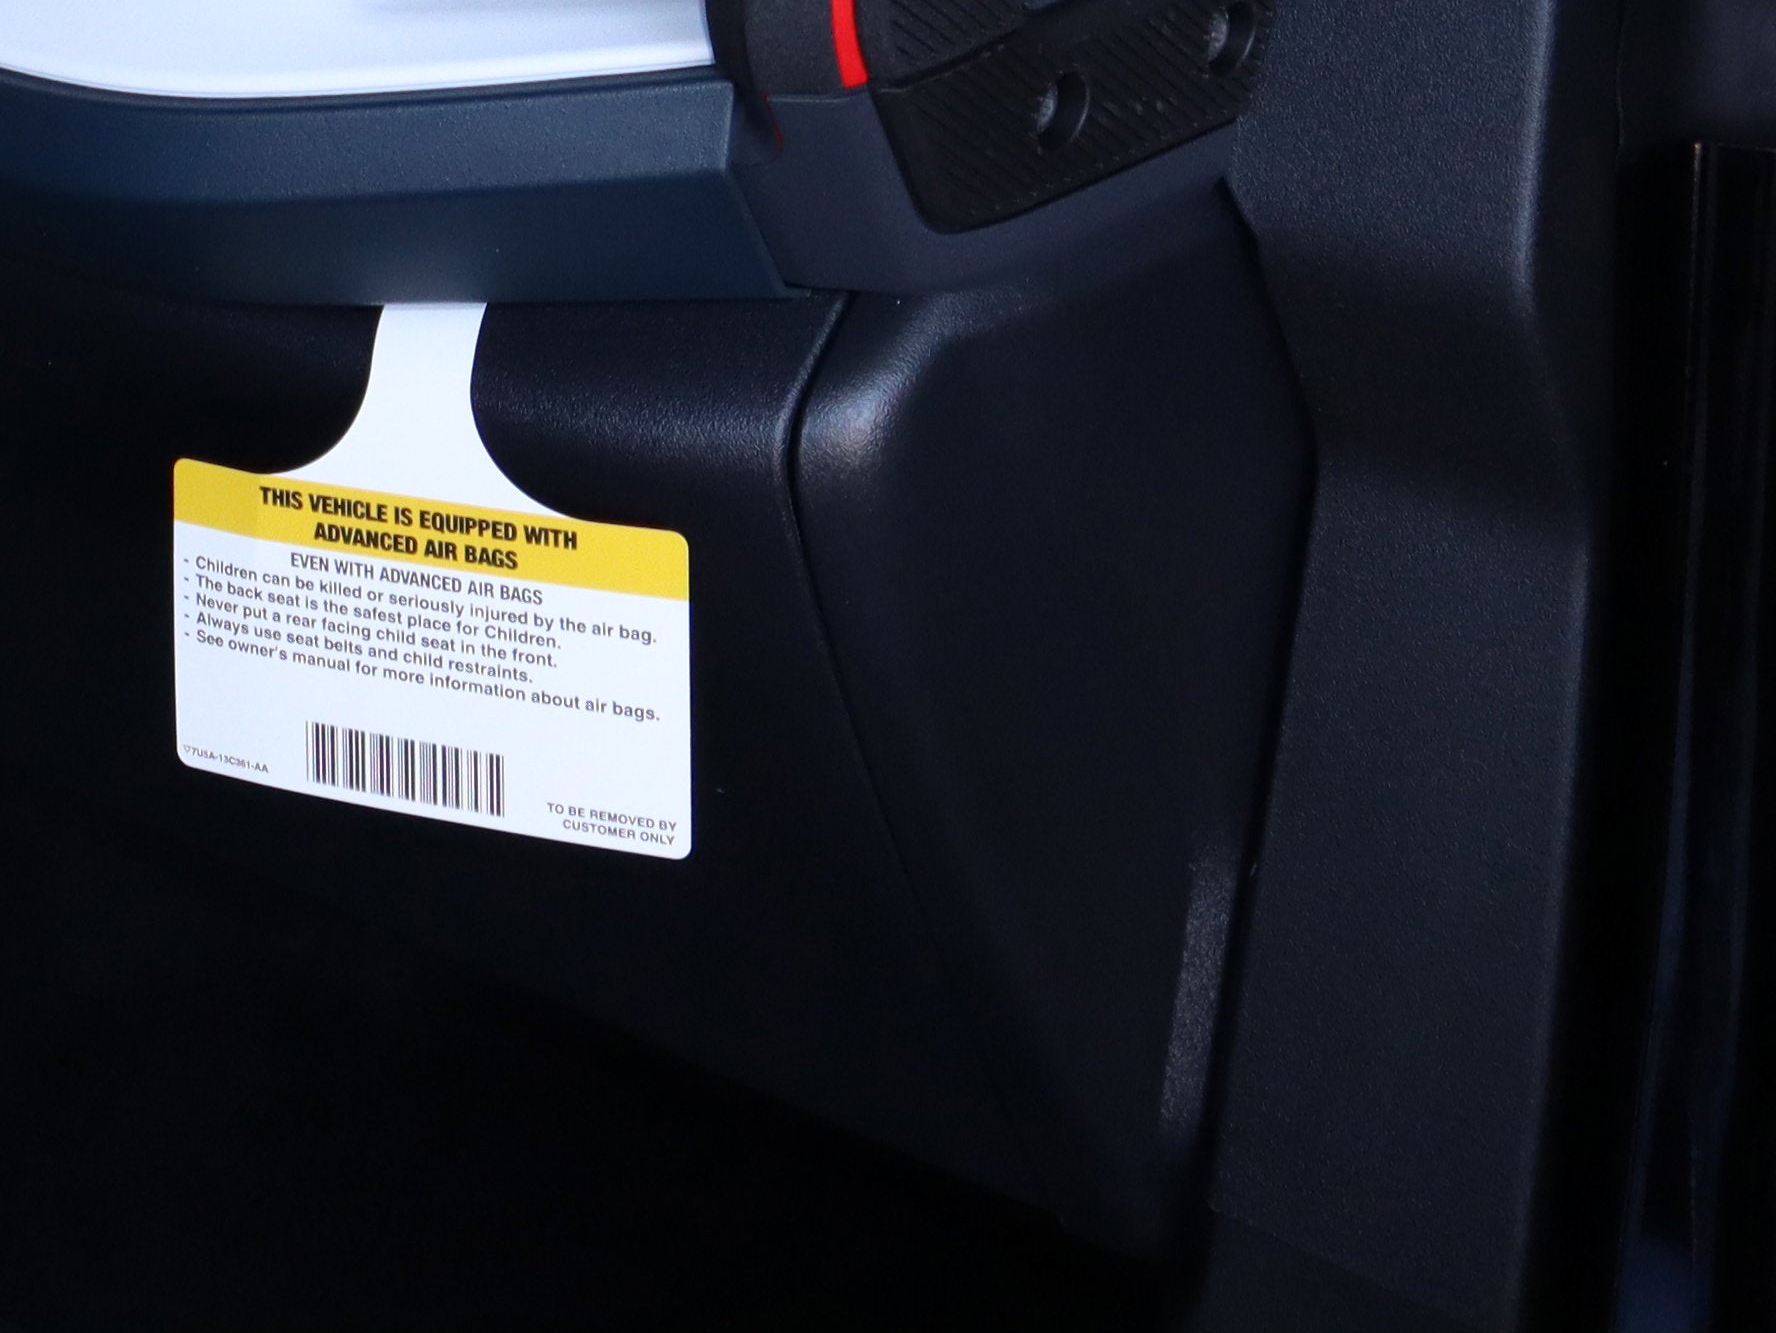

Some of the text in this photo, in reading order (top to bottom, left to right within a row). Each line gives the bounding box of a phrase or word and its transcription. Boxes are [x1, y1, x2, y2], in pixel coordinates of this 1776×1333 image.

[258, 485, 578, 551] THIS VEHICLE IS EQUIPPED WITH
[313, 521, 519, 571] ADVANCED AIR BAGS
[195, 555, 657, 646] Children can be killed or seriously injured by the air bag.
[195, 572, 561, 650] The back seat is the safest place for Children.
[290, 551, 543, 606] EVEN WITH ADVANCED AIR BAGS
[196, 591, 557, 668] Never put a rear facing child seat in the front.
[196, 610, 533, 684] Always use seat belts and child restraints.
[196, 628, 660, 723] See owner's manual for more information about air bags.
[547, 802, 677, 832] TO BE REMOVED BY
[562, 819, 675, 846] CUSTOMER ONLY
